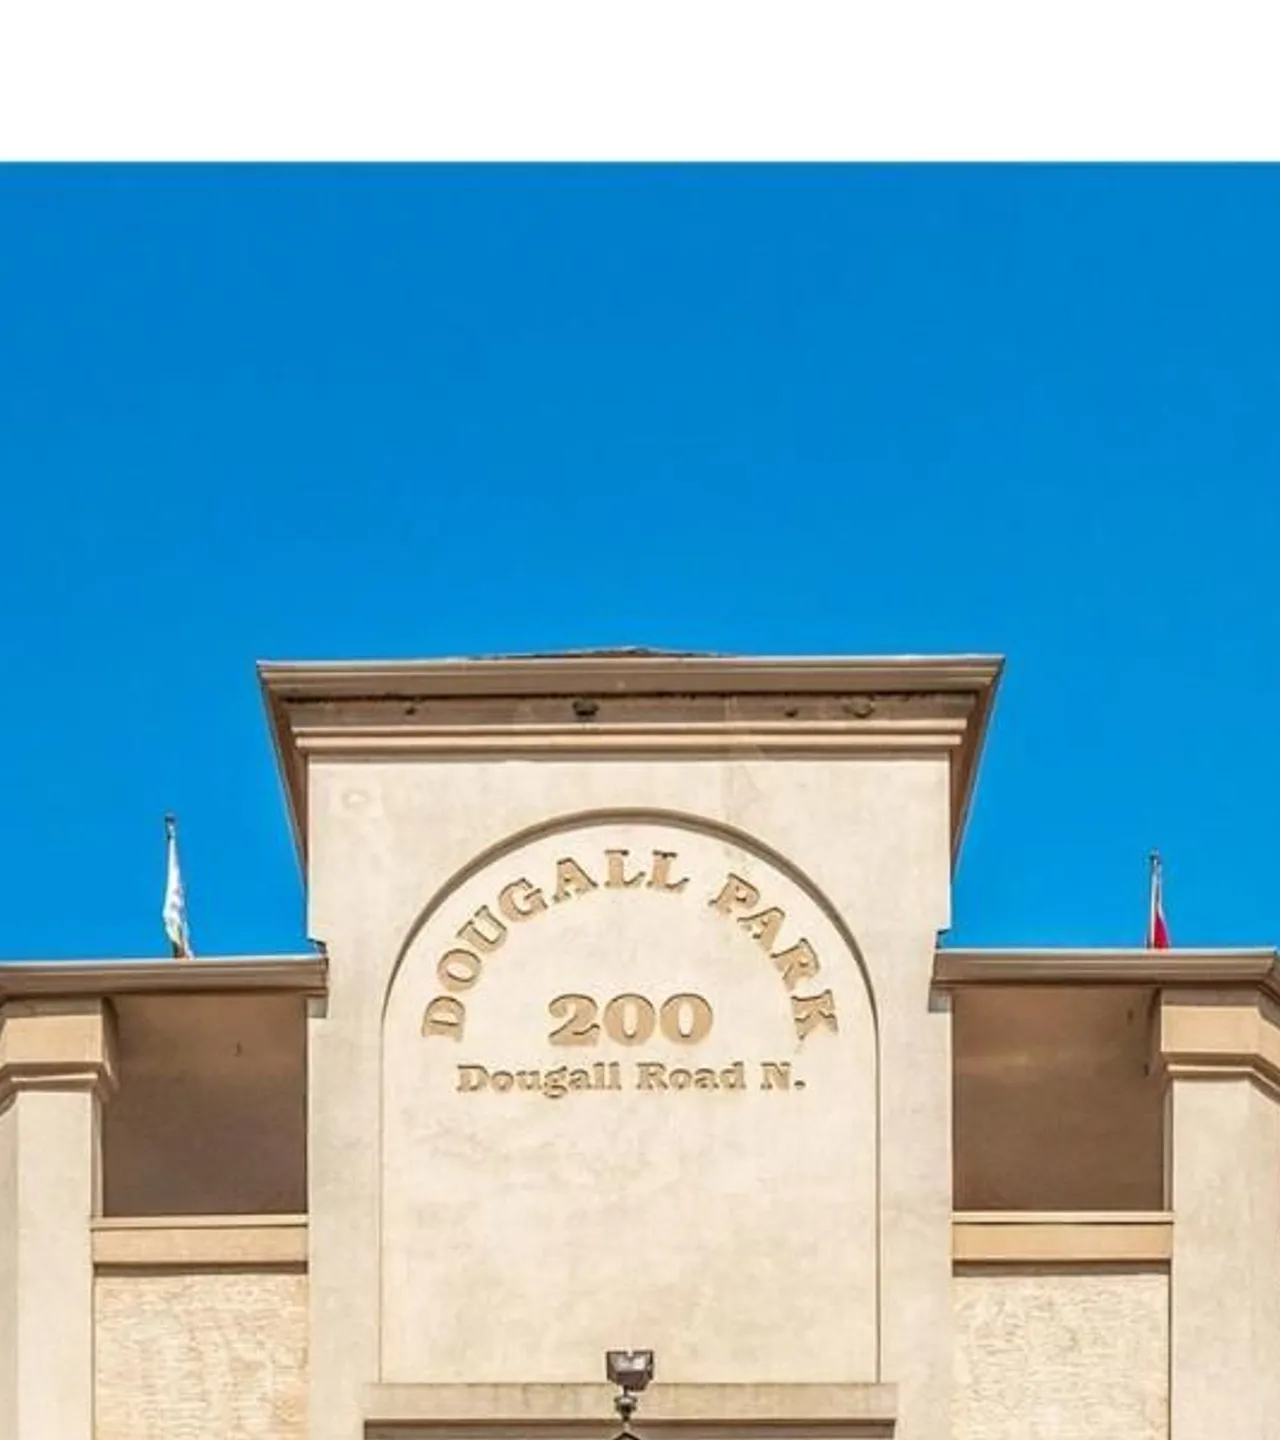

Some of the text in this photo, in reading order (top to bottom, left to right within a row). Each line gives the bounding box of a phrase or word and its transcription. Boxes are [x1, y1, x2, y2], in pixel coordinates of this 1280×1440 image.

[421, 849, 839, 1042] DOUGALL PARK
[548, 992, 714, 1046] 200
[456, 1060, 806, 1099] Dougall Road N.
